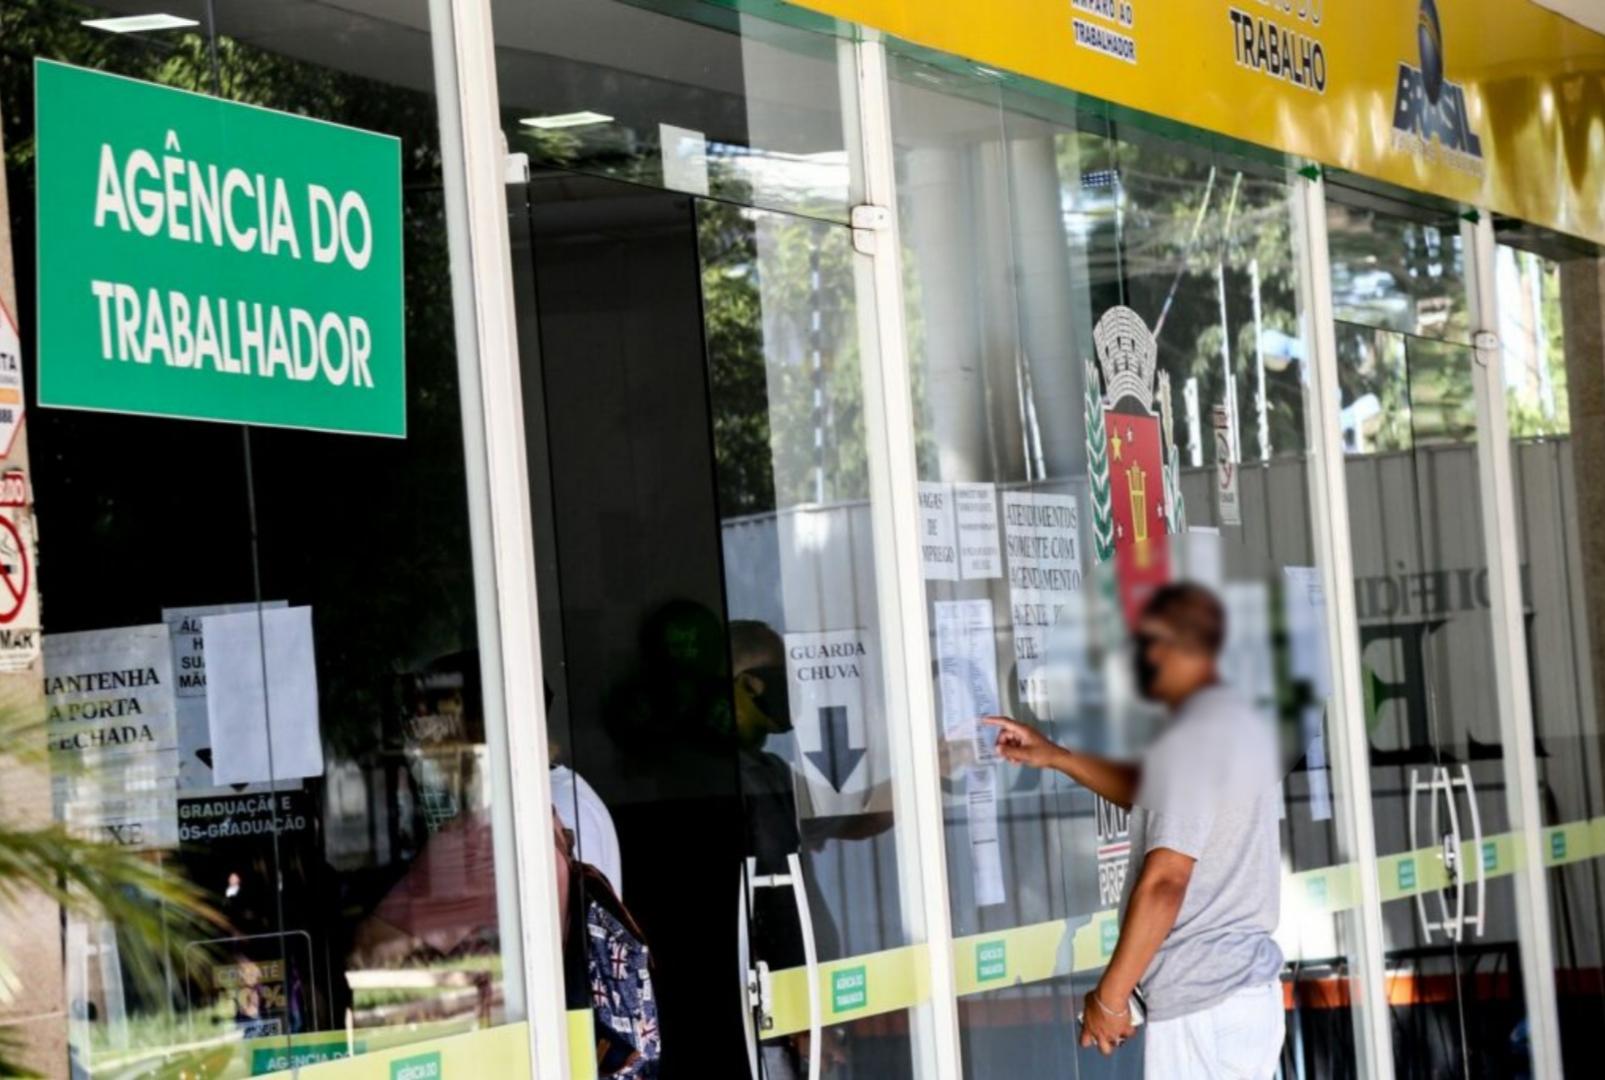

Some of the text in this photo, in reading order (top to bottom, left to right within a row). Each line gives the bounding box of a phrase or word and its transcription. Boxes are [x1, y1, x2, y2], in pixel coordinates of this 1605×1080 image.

[1074, 20, 1136, 61] TRABALHADOR
[1230, 9, 1325, 92] TRABALHO
[94, 129, 373, 271] AGÊNCIA DO
[91, 279, 375, 389] TRABALHADOR
[790, 641, 867, 661] GUARDA
[797, 664, 860, 682] CHUVA
[66, 698, 143, 722] PORTA
[180, 795, 292, 818] GRADUAÇÃO E
